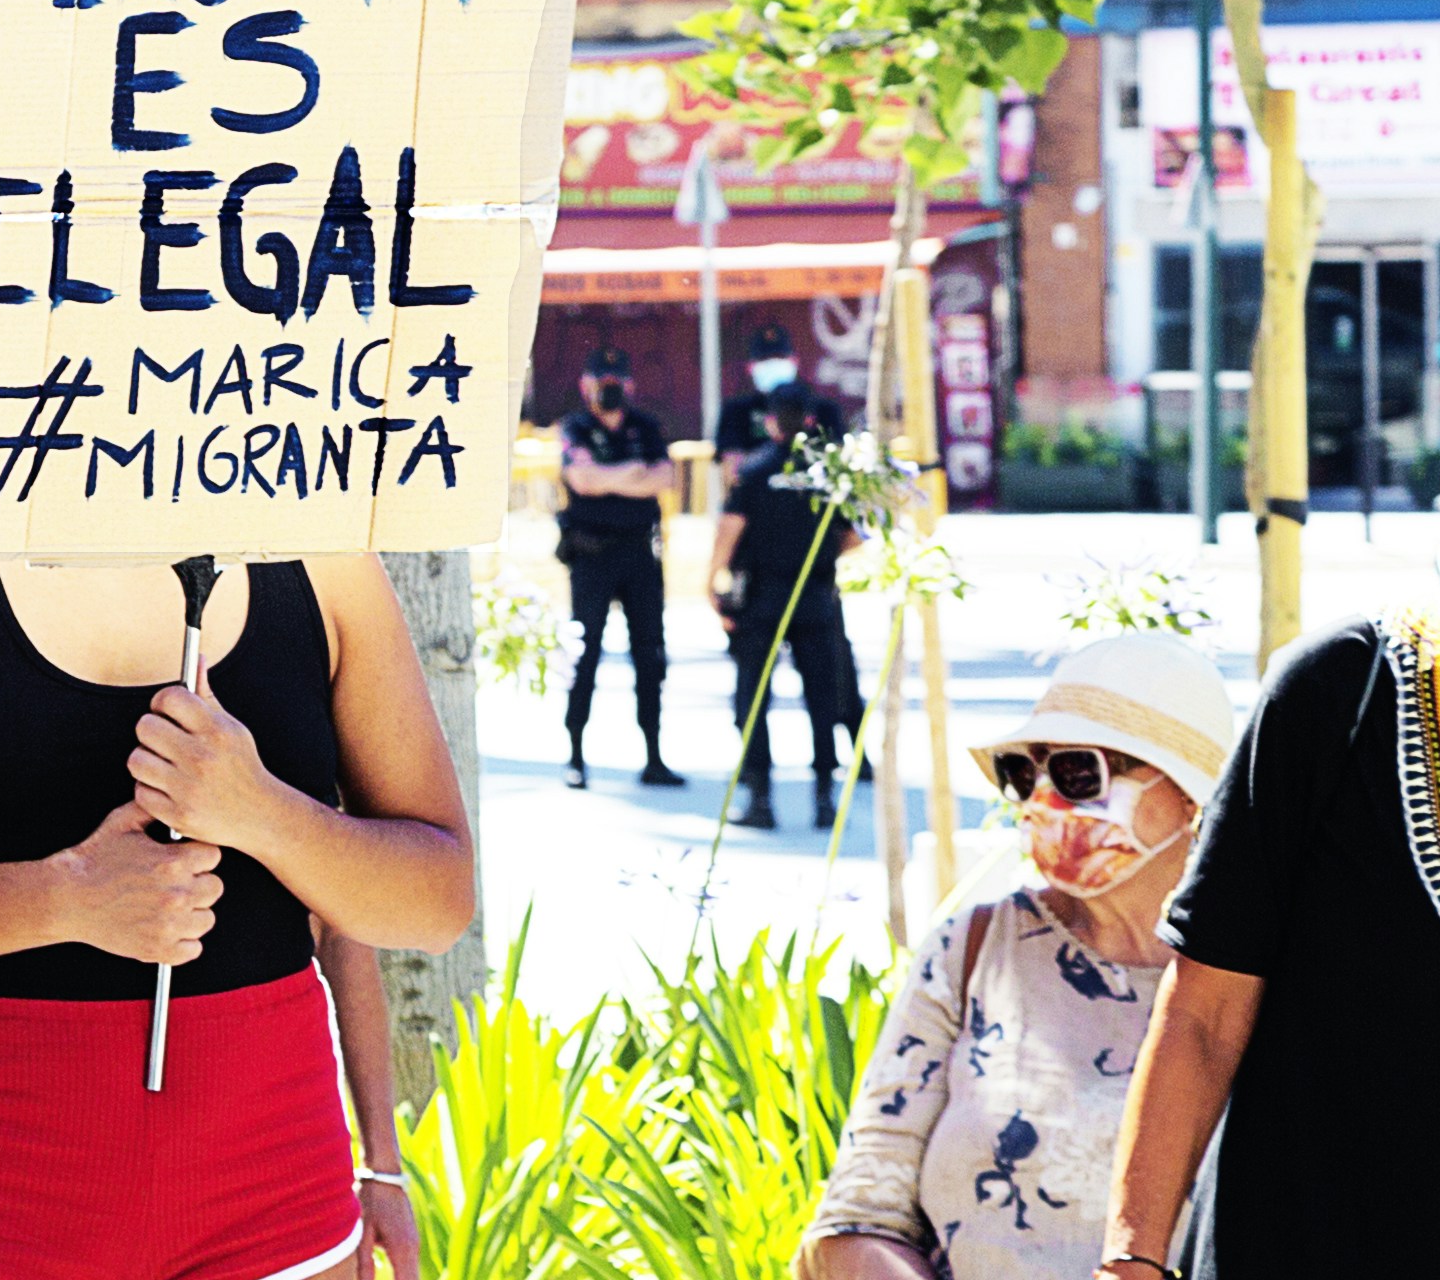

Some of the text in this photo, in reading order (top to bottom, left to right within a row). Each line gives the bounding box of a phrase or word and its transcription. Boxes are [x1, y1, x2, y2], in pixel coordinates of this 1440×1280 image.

[110, 9, 322, 153] ES
[128, 333, 473, 416] MARICA
[85, 415, 466, 500] MIGRANTA
